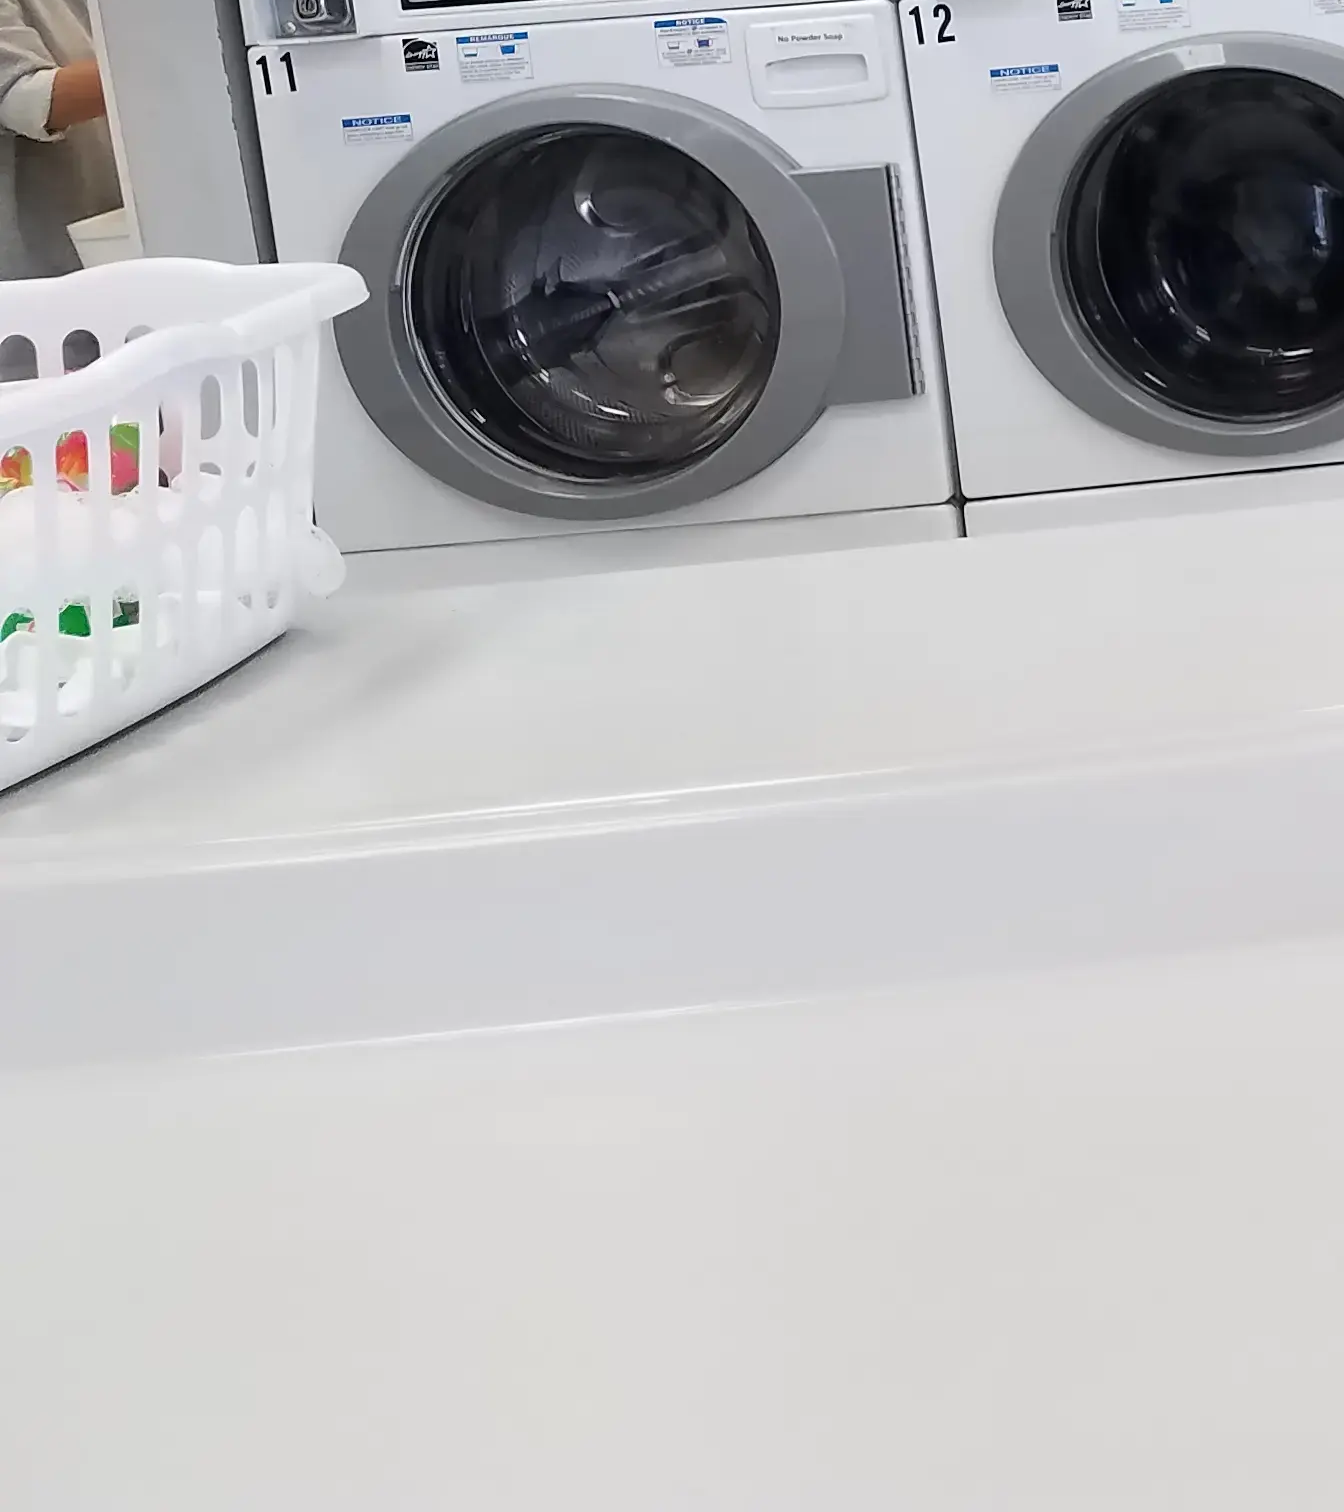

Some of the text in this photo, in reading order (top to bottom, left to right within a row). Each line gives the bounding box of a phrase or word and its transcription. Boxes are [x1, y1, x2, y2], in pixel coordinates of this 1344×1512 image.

[675, 18, 706, 27] NOTICE
[907, 3, 956, 46] 12
[791, 33, 821, 42] Powder
[824, 32, 843, 41] Soap
[255, 51, 299, 97] 11
[999, 65, 1050, 76] NOTICE
[351, 115, 402, 127] NOTICE
